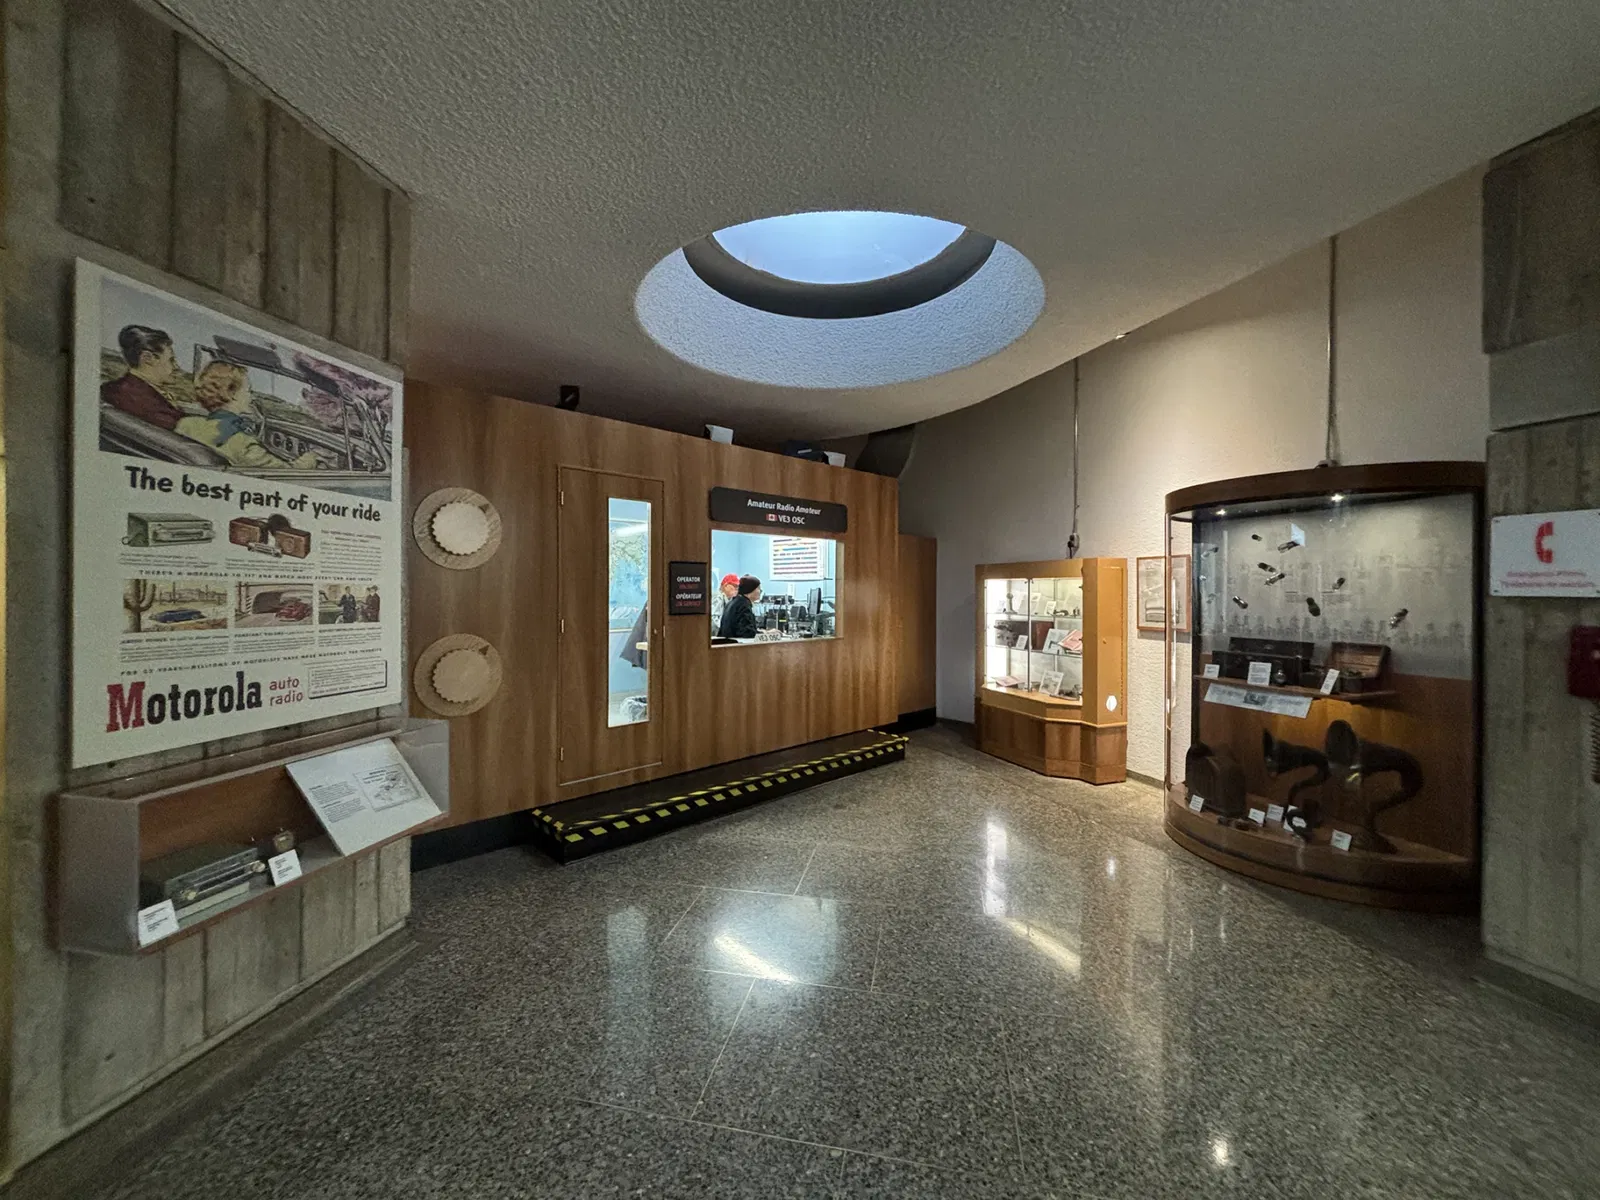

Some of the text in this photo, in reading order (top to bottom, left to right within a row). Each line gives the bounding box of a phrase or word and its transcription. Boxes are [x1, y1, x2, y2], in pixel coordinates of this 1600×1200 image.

[124, 466, 381, 521] The best part of your ride
[747, 498, 821, 515] Amateur Radio Amateur
[778, 515, 805, 525] VE3 OSC
[106, 671, 262, 733] Motorola
[269, 676, 300, 691] auto
[269, 691, 304, 707] radio
